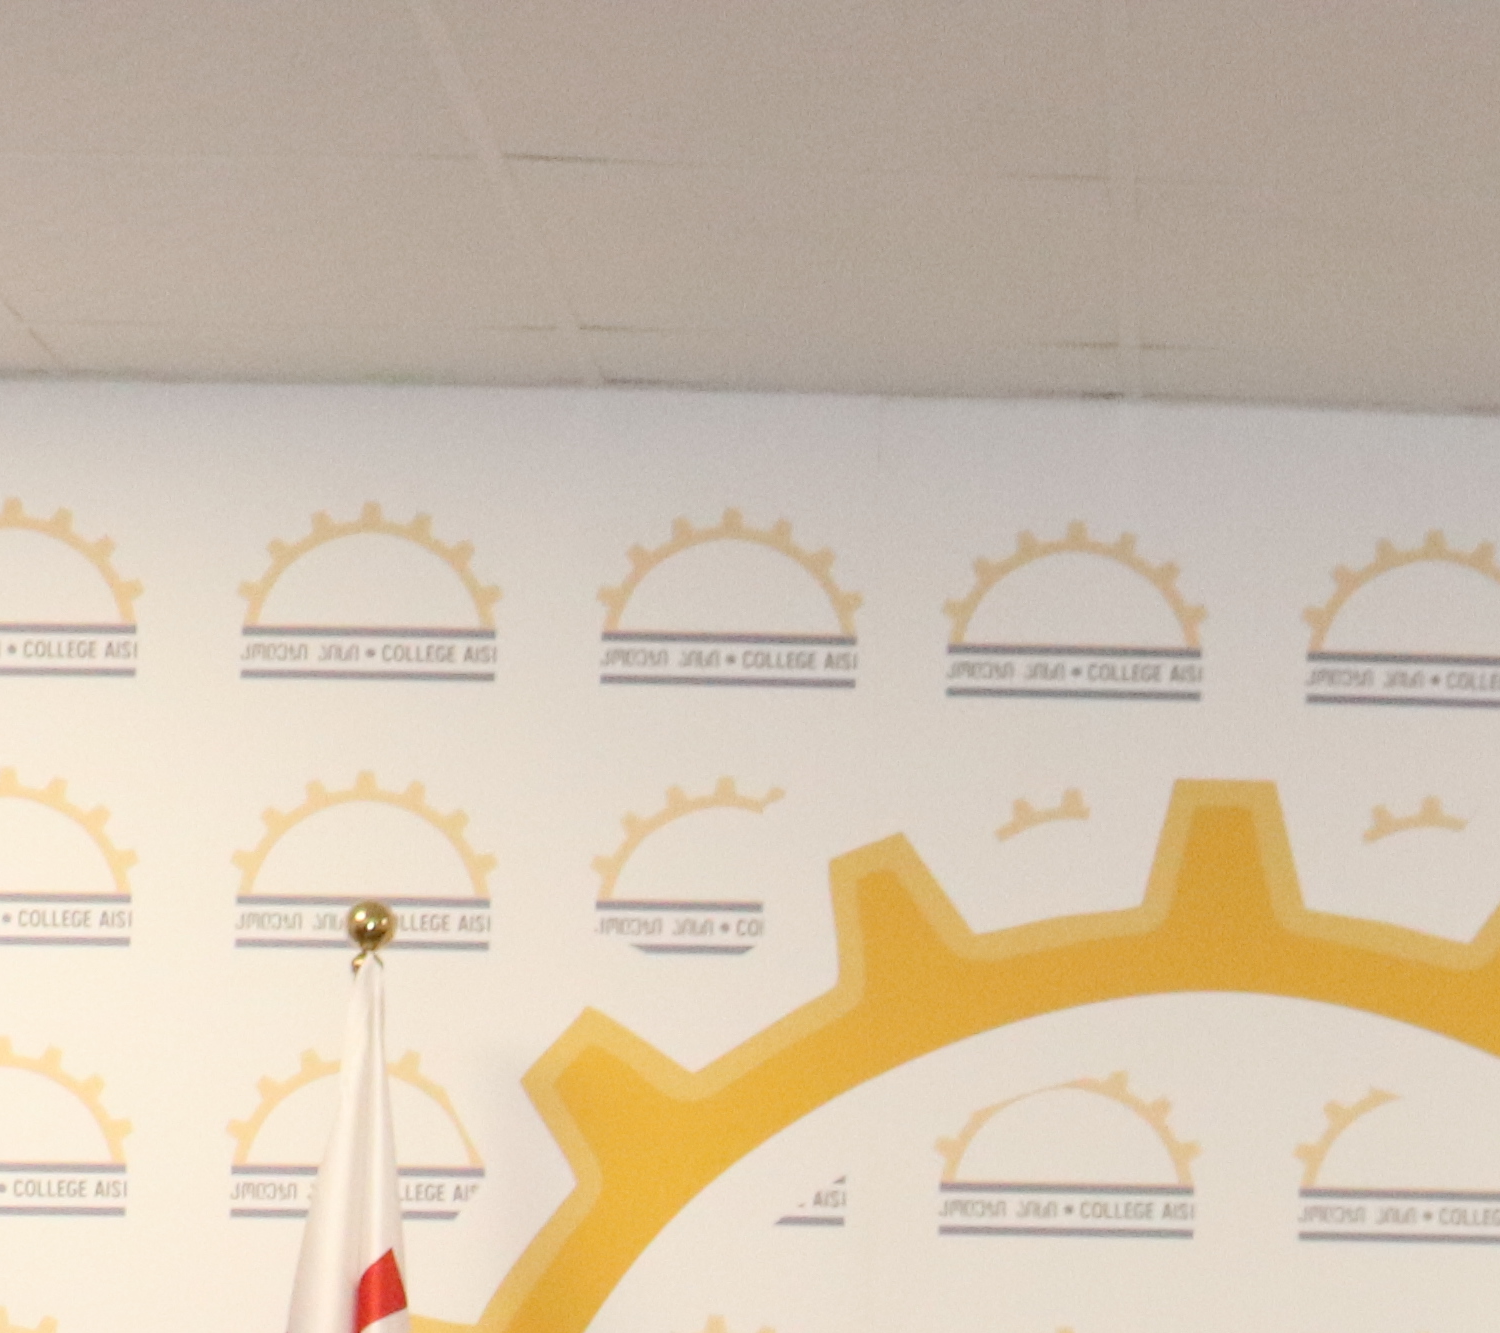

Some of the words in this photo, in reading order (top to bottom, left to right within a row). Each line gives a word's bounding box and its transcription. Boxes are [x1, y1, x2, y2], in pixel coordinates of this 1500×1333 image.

[23, 641, 98, 658] COLLEGE
[104, 641, 138, 658] AISI
[382, 645, 457, 662] COLLEGE
[463, 646, 497, 663] AISI
[742, 651, 817, 669] COLLEGE
[824, 652, 858, 670] AISI
[1087, 664, 1162, 681] COLLEGE
[18, 910, 92, 927] COLLEGE
[99, 910, 132, 927] AISI
[397, 914, 452, 931] LLEGE
[459, 915, 493, 932] AISI
[13, 1180, 88, 1197] COLLEGE
[95, 1180, 129, 1198] AISI
[397, 1184, 446, 1201] LLEGE
[1080, 1201, 1155, 1219] COLLEGE
